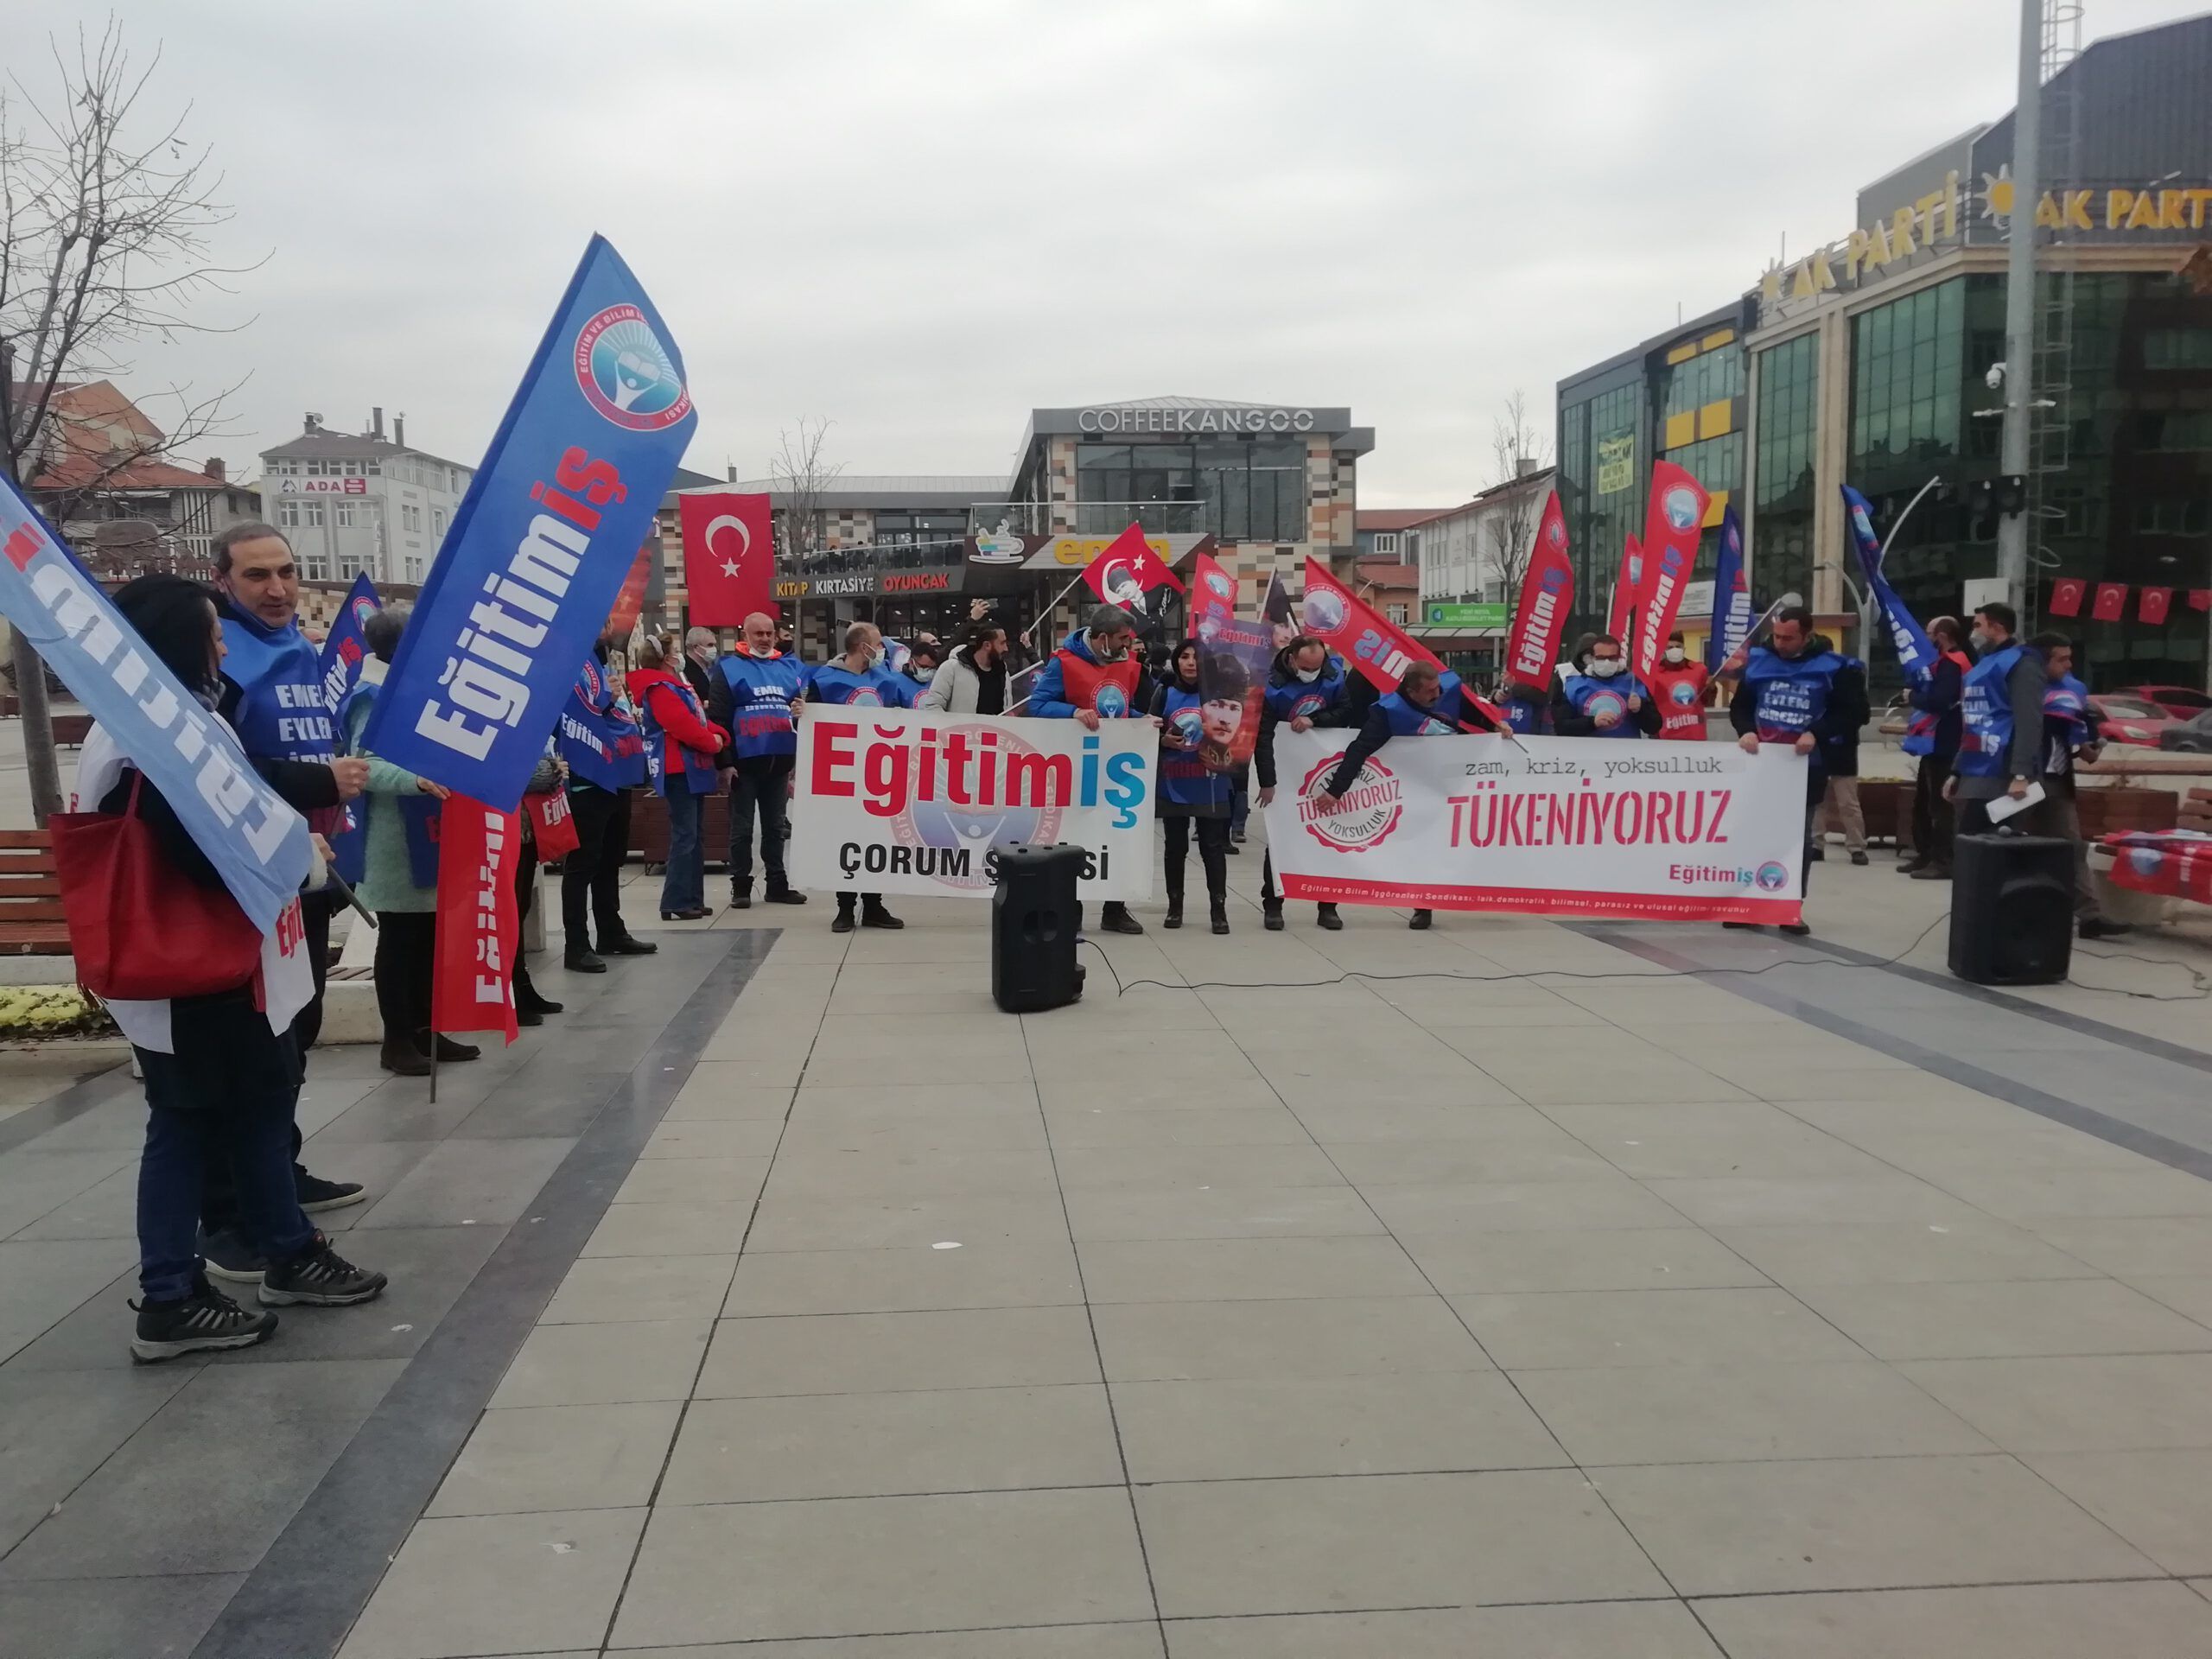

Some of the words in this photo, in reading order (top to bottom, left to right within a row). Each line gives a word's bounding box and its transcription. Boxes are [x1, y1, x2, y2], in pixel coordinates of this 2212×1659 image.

[2035, 189, 2094, 230] AK
[2106, 188, 2212, 230] PART
[1792, 241, 1837, 300] AK
[1846, 169, 1960, 281] PARTİ
[578, 334, 594, 373] EĞİTİM
[589, 321, 603, 334] VE
[604, 308, 635, 325] BİLİM
[1078, 409, 1314, 432] COFFEEKANGOO
[305, 480, 342, 492] ADA
[883, 573, 950, 592] OYUNCAK
[415, 445, 628, 762] Eğitimiş
[275, 684, 326, 709] EME
[1666, 714, 1699, 730] Eğitim
[811, 721, 1146, 830] Eğitimiş
[1356, 768, 1376, 785] RİZ
[1465, 760, 1510, 778] zam,
[1525, 758, 1586, 778] kriz,
[1604, 756, 1723, 779] yoksulluk
[1328, 809, 1387, 838] YOKSULLUK
[1447, 778, 1732, 849] TÜKENİYORUZ
[839, 842, 970, 880] ÇORUM
[984, 844, 1109, 887] ŞSİ
[1669, 863, 1754, 887] Eğitimiş
[1300, 883, 1331, 893] Eğitim
[1344, 887, 1370, 896] Bilim
